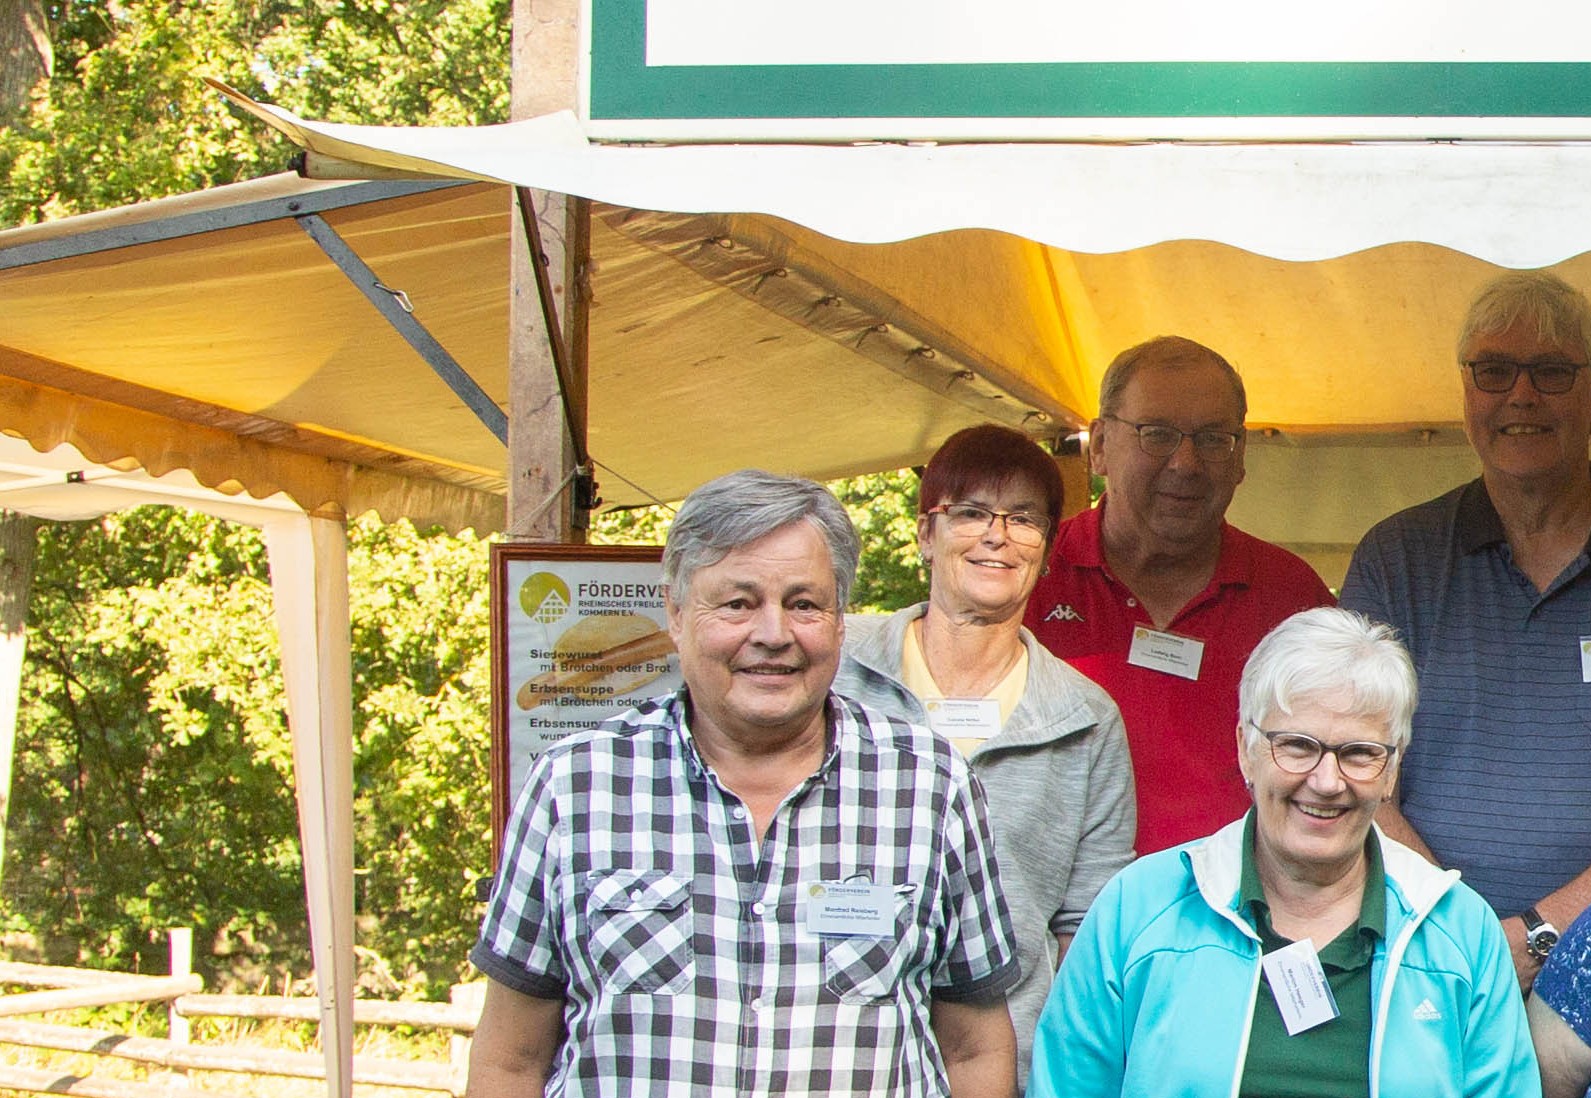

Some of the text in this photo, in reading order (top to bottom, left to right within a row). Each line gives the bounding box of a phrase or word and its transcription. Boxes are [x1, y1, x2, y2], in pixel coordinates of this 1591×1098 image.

[578, 600, 631, 608] RHEINISCHES
[540, 663, 556, 672] mit
[616, 663, 642, 672] oder
[646, 663, 671, 672] Brot
[530, 684, 614, 696] Erbsensuppe
[540, 697, 559, 706] mit
[617, 697, 642, 706] oder
